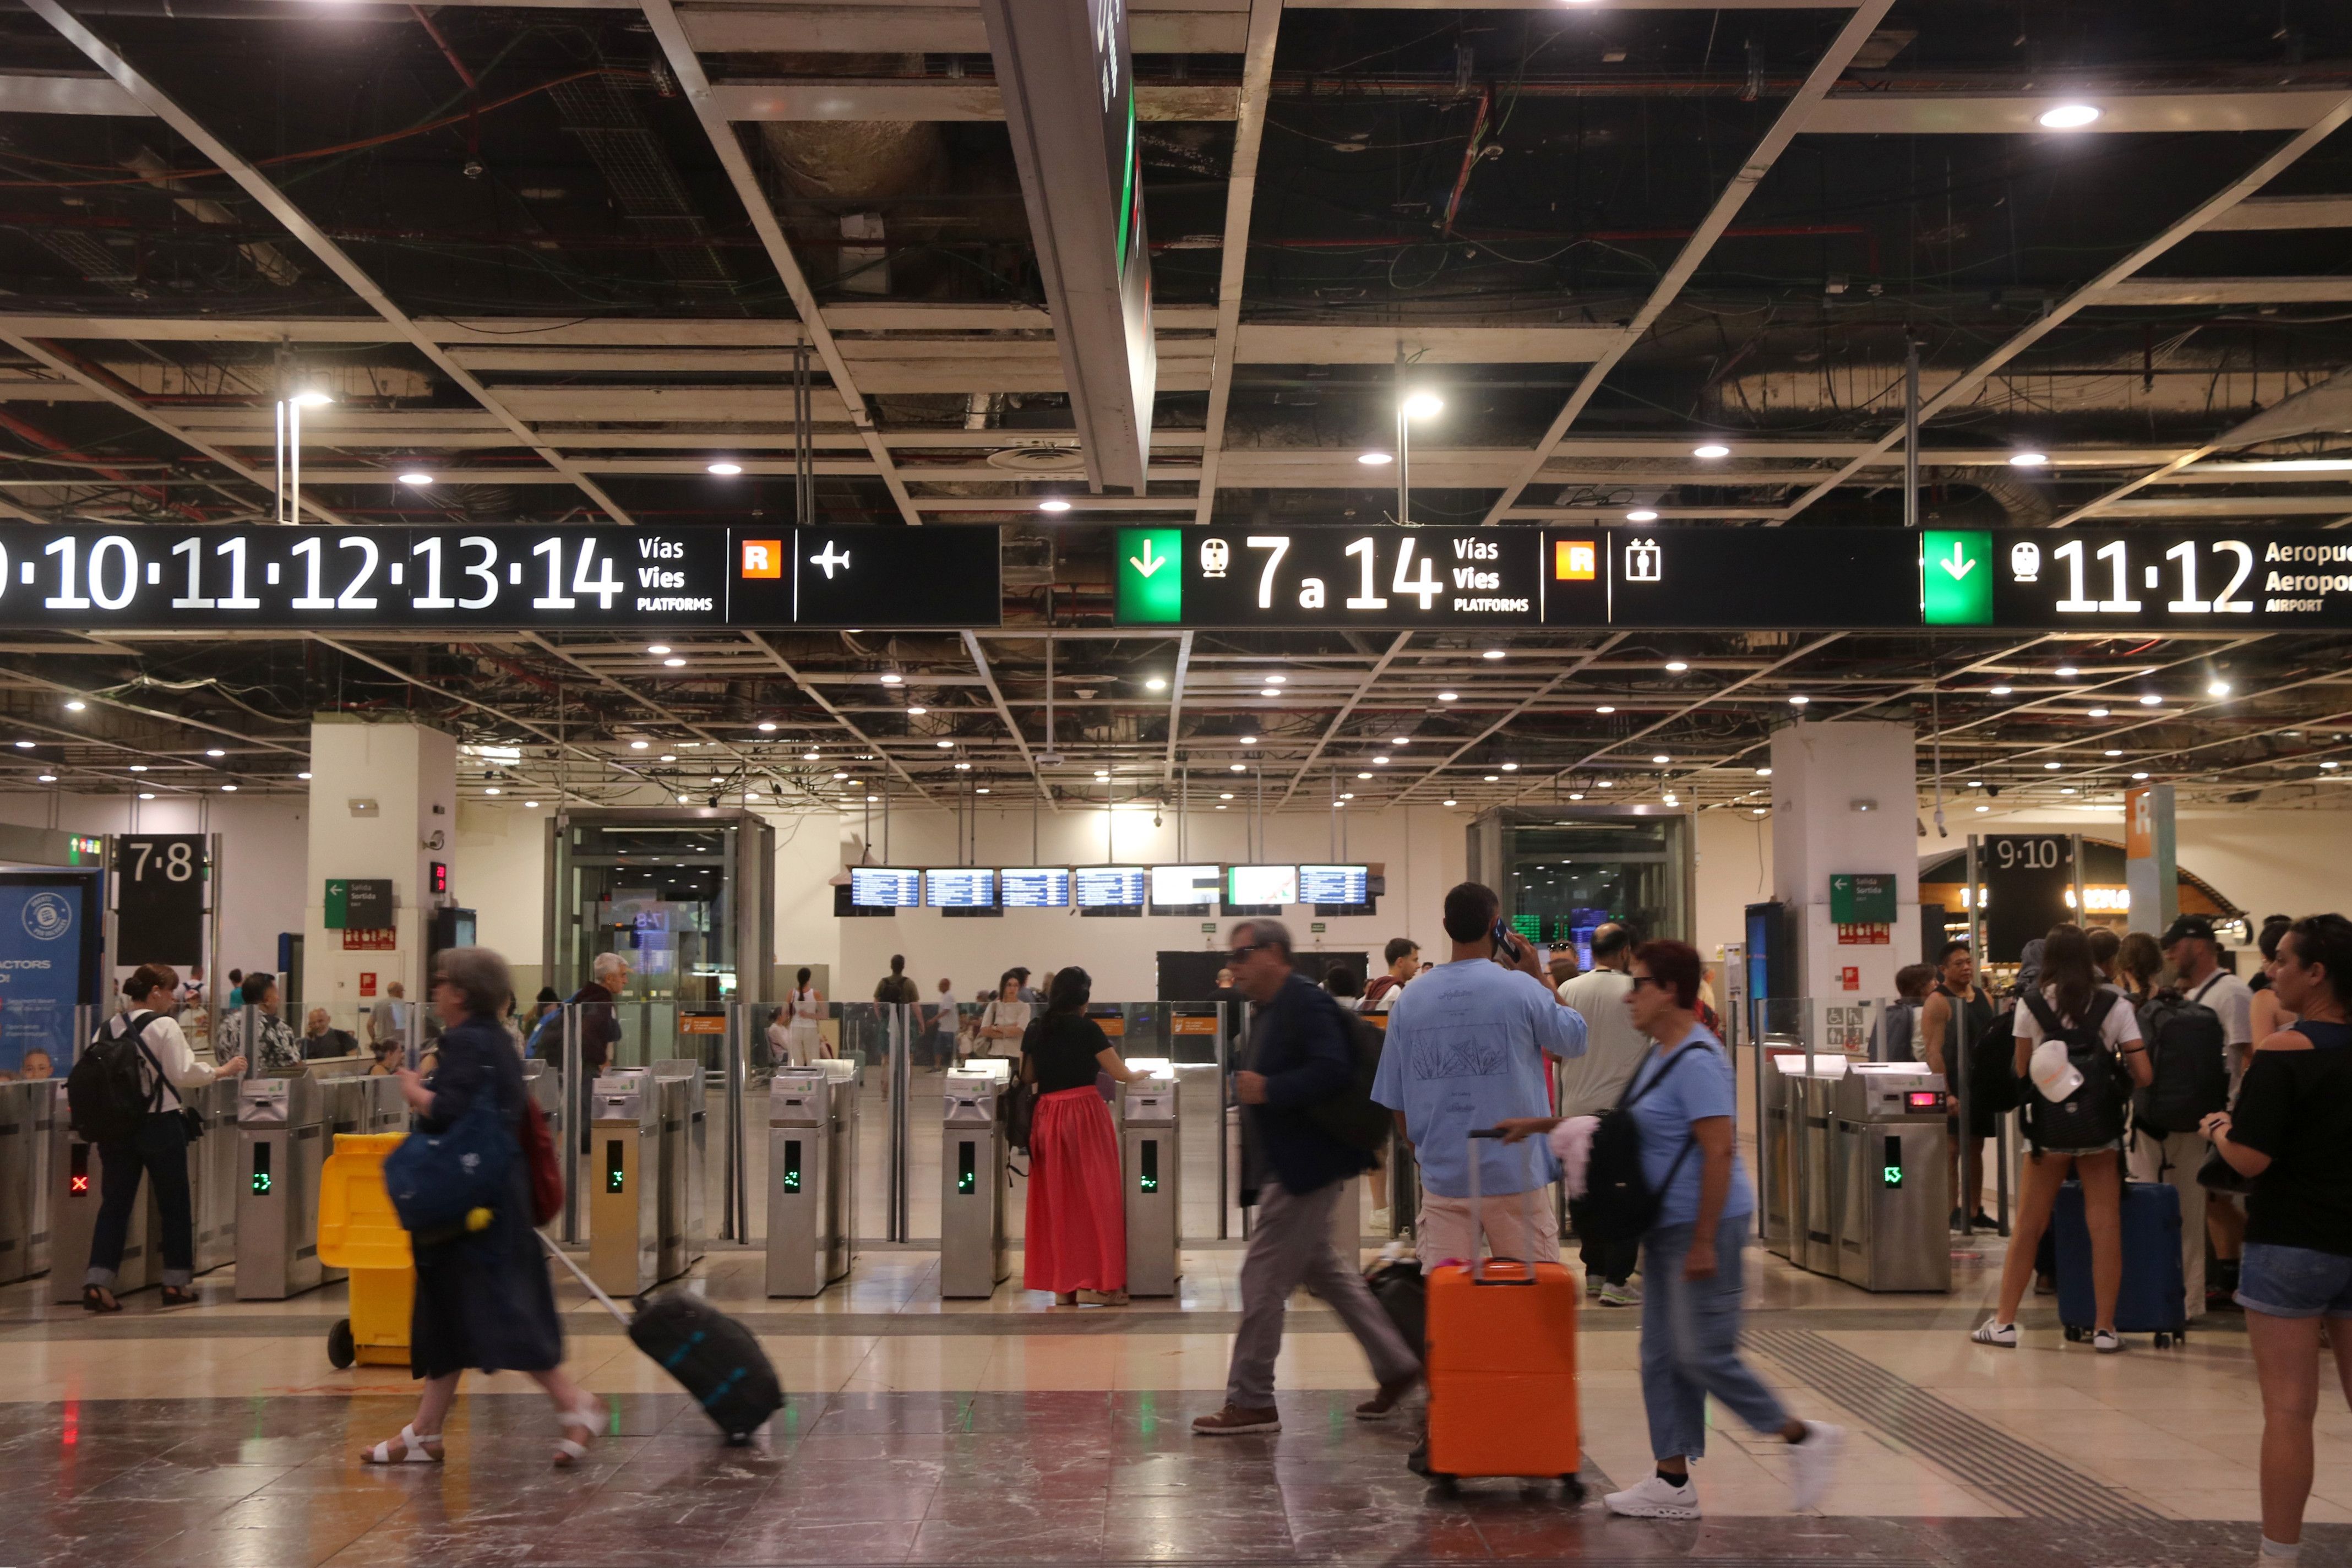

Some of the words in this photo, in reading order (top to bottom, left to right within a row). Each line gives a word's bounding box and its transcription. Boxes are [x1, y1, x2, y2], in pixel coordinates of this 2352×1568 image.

[639, 536, 684, 559] Vías
[745, 546, 768, 570] R
[1453, 537, 1499, 560] Vías
[1569, 547, 1595, 571] R
[638, 565, 685, 589] Vies
[1246, 536, 1291, 609] 7
[1299, 578, 1325, 609] a
[1345, 537, 1444, 610] 14
[1452, 566, 1500, 590] Vies
[637, 597, 713, 611] PLATFORMS
[1453, 598, 1529, 612] PLATFORMS
[2264, 598, 2324, 613] AIRPORT
